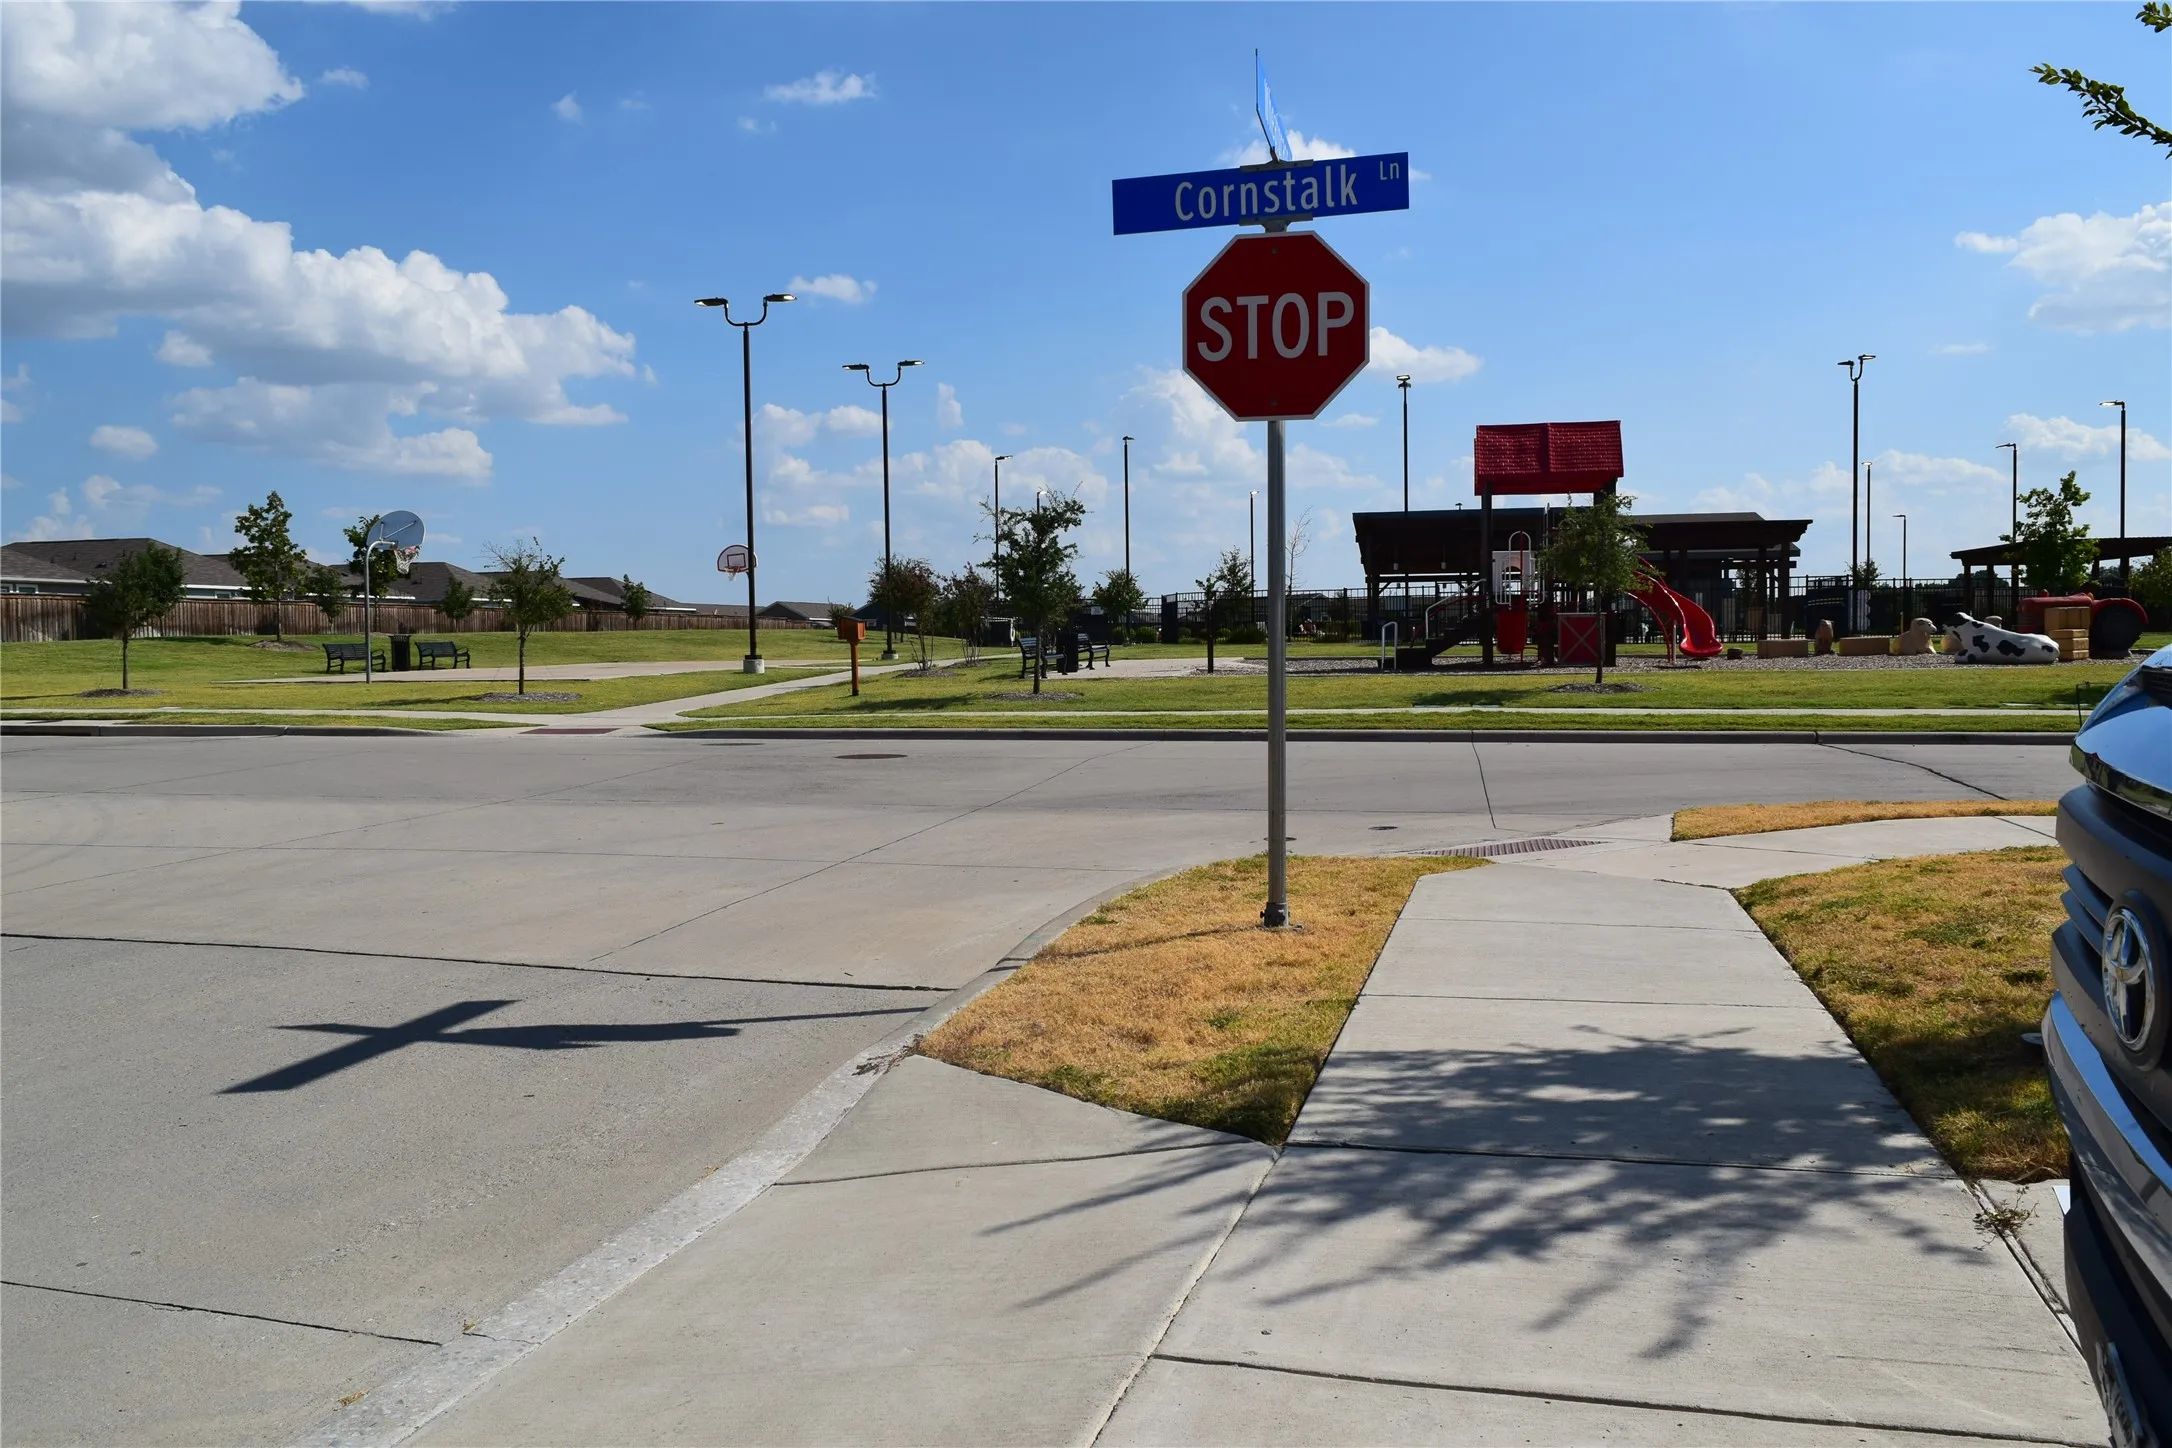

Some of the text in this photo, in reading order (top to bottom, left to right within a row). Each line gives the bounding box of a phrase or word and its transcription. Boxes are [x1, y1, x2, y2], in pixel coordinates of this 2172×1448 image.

[1175, 160, 1400, 221] Cornstalk Ln
[1197, 292, 1355, 362] STOP
